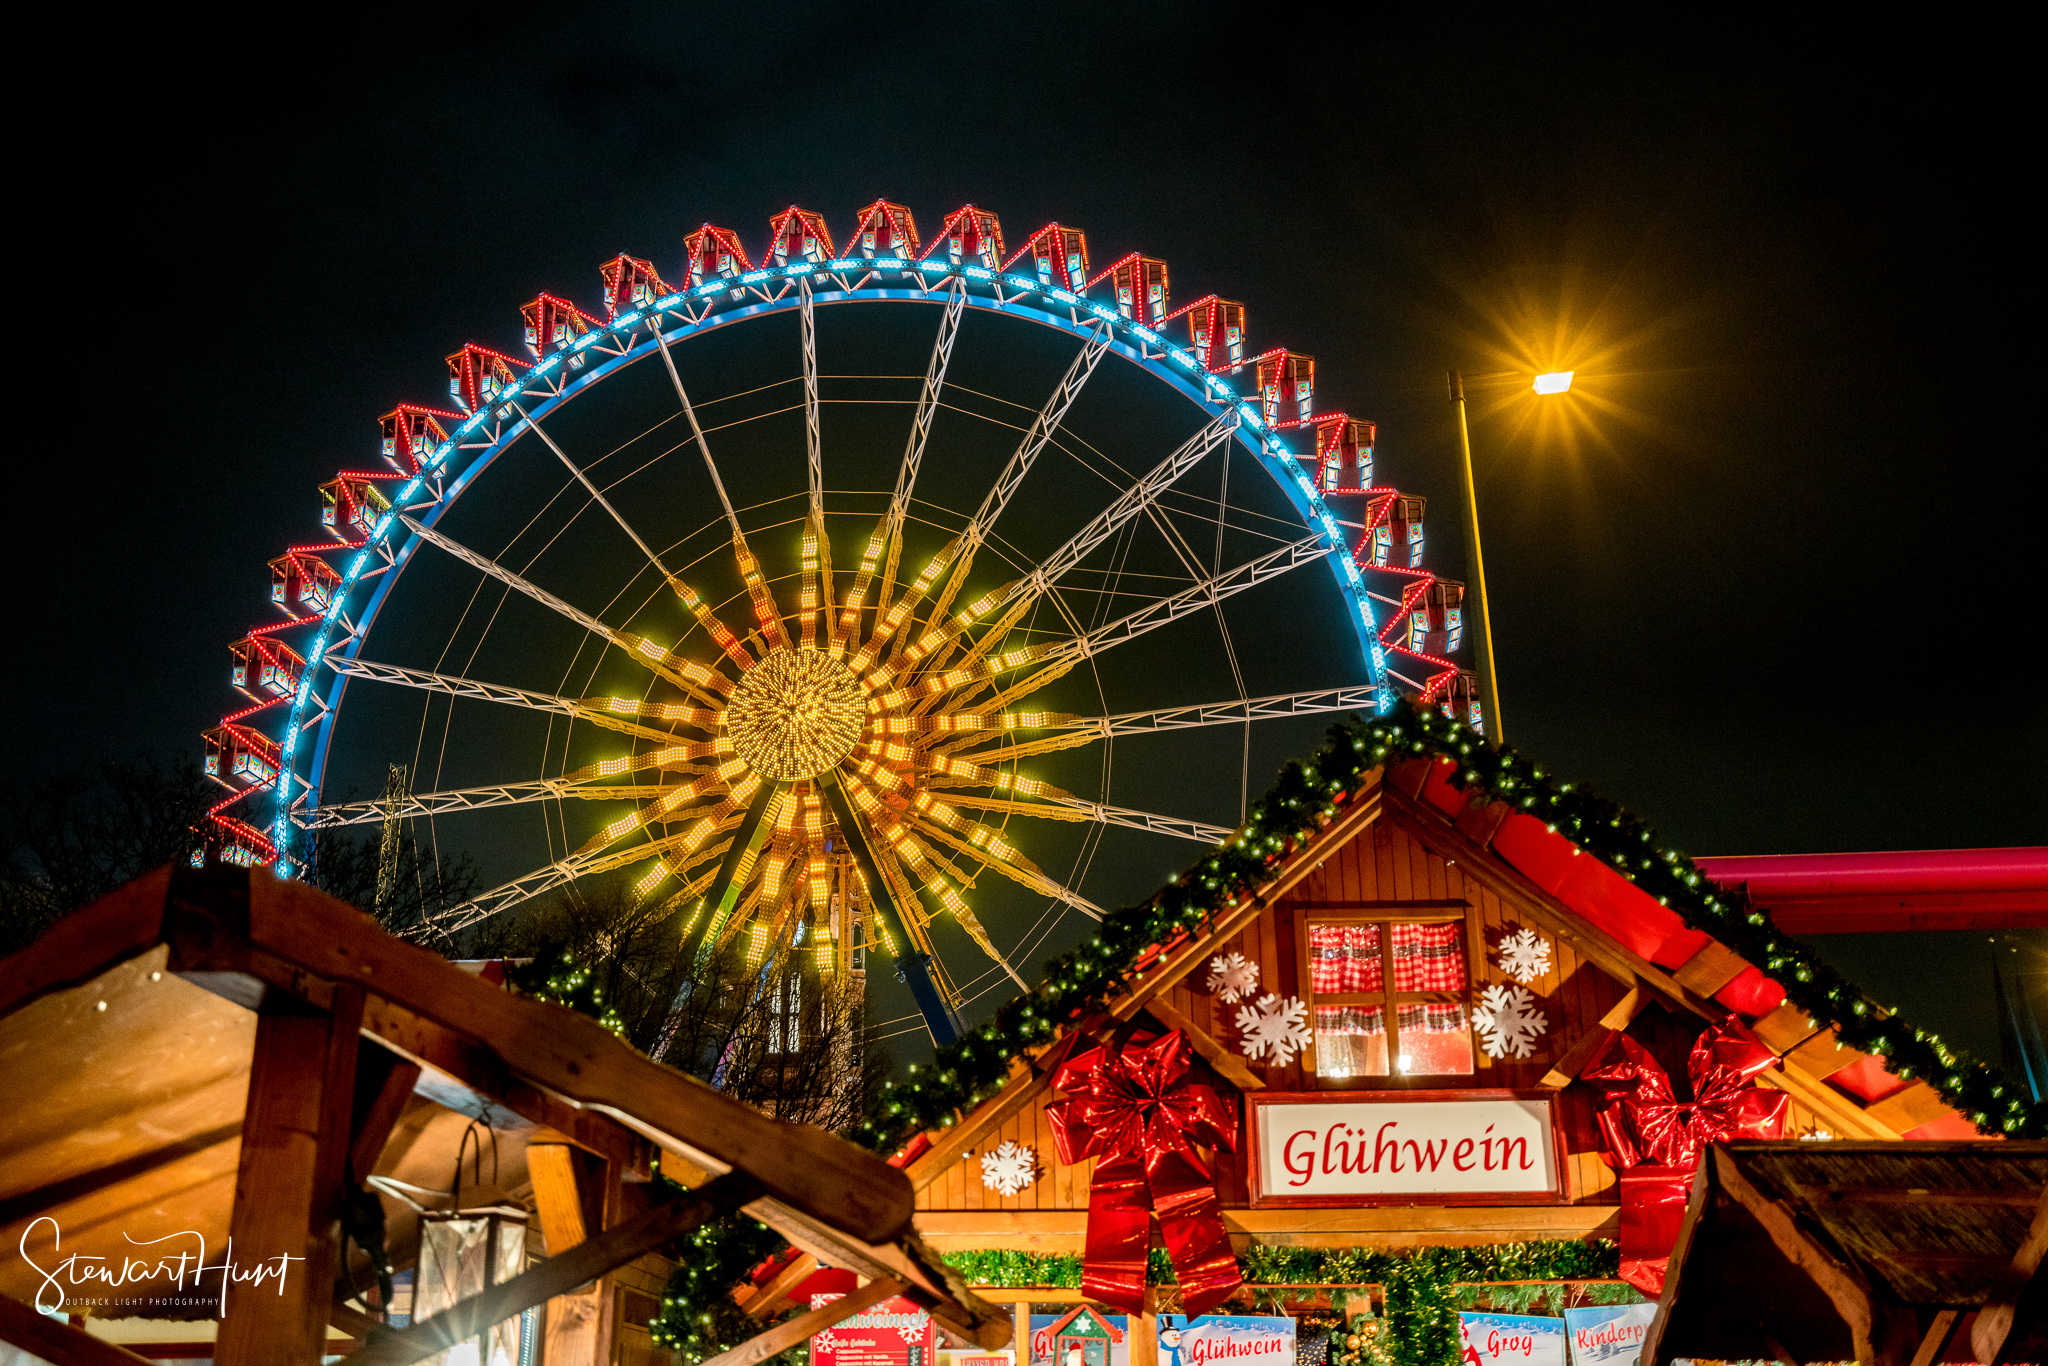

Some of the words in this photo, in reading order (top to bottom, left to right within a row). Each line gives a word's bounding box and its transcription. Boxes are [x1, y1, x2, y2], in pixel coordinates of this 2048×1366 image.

[1283, 1121, 1535, 1187] Glühwein
[822, 1306, 930, 1331] hweineck
[1192, 1334, 1282, 1366] Glühwein
[1487, 1329, 1532, 1358] Grog
